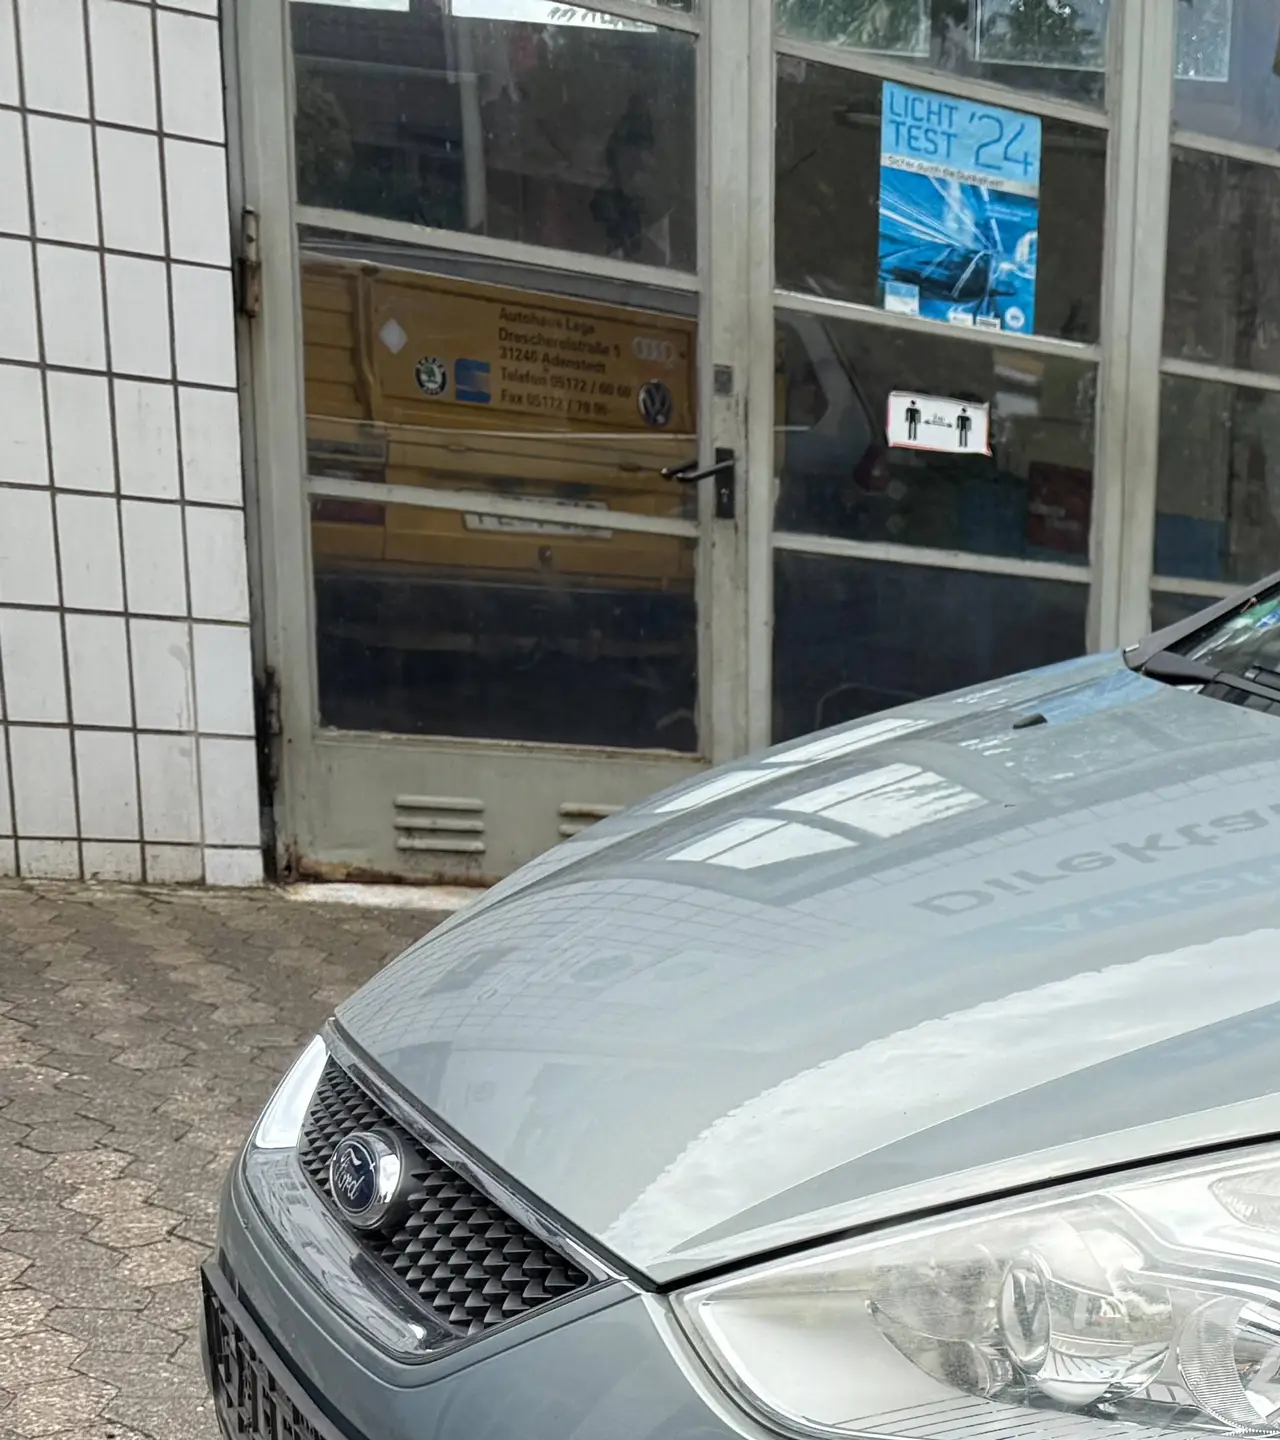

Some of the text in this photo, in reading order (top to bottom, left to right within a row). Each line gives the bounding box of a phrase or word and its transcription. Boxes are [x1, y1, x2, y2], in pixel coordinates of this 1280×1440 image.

[889, 90, 959, 129] LICHT
[888, 120, 958, 159] TEST
[500, 389, 523, 404] Fax
[334, 1148, 365, 1201] Ford
